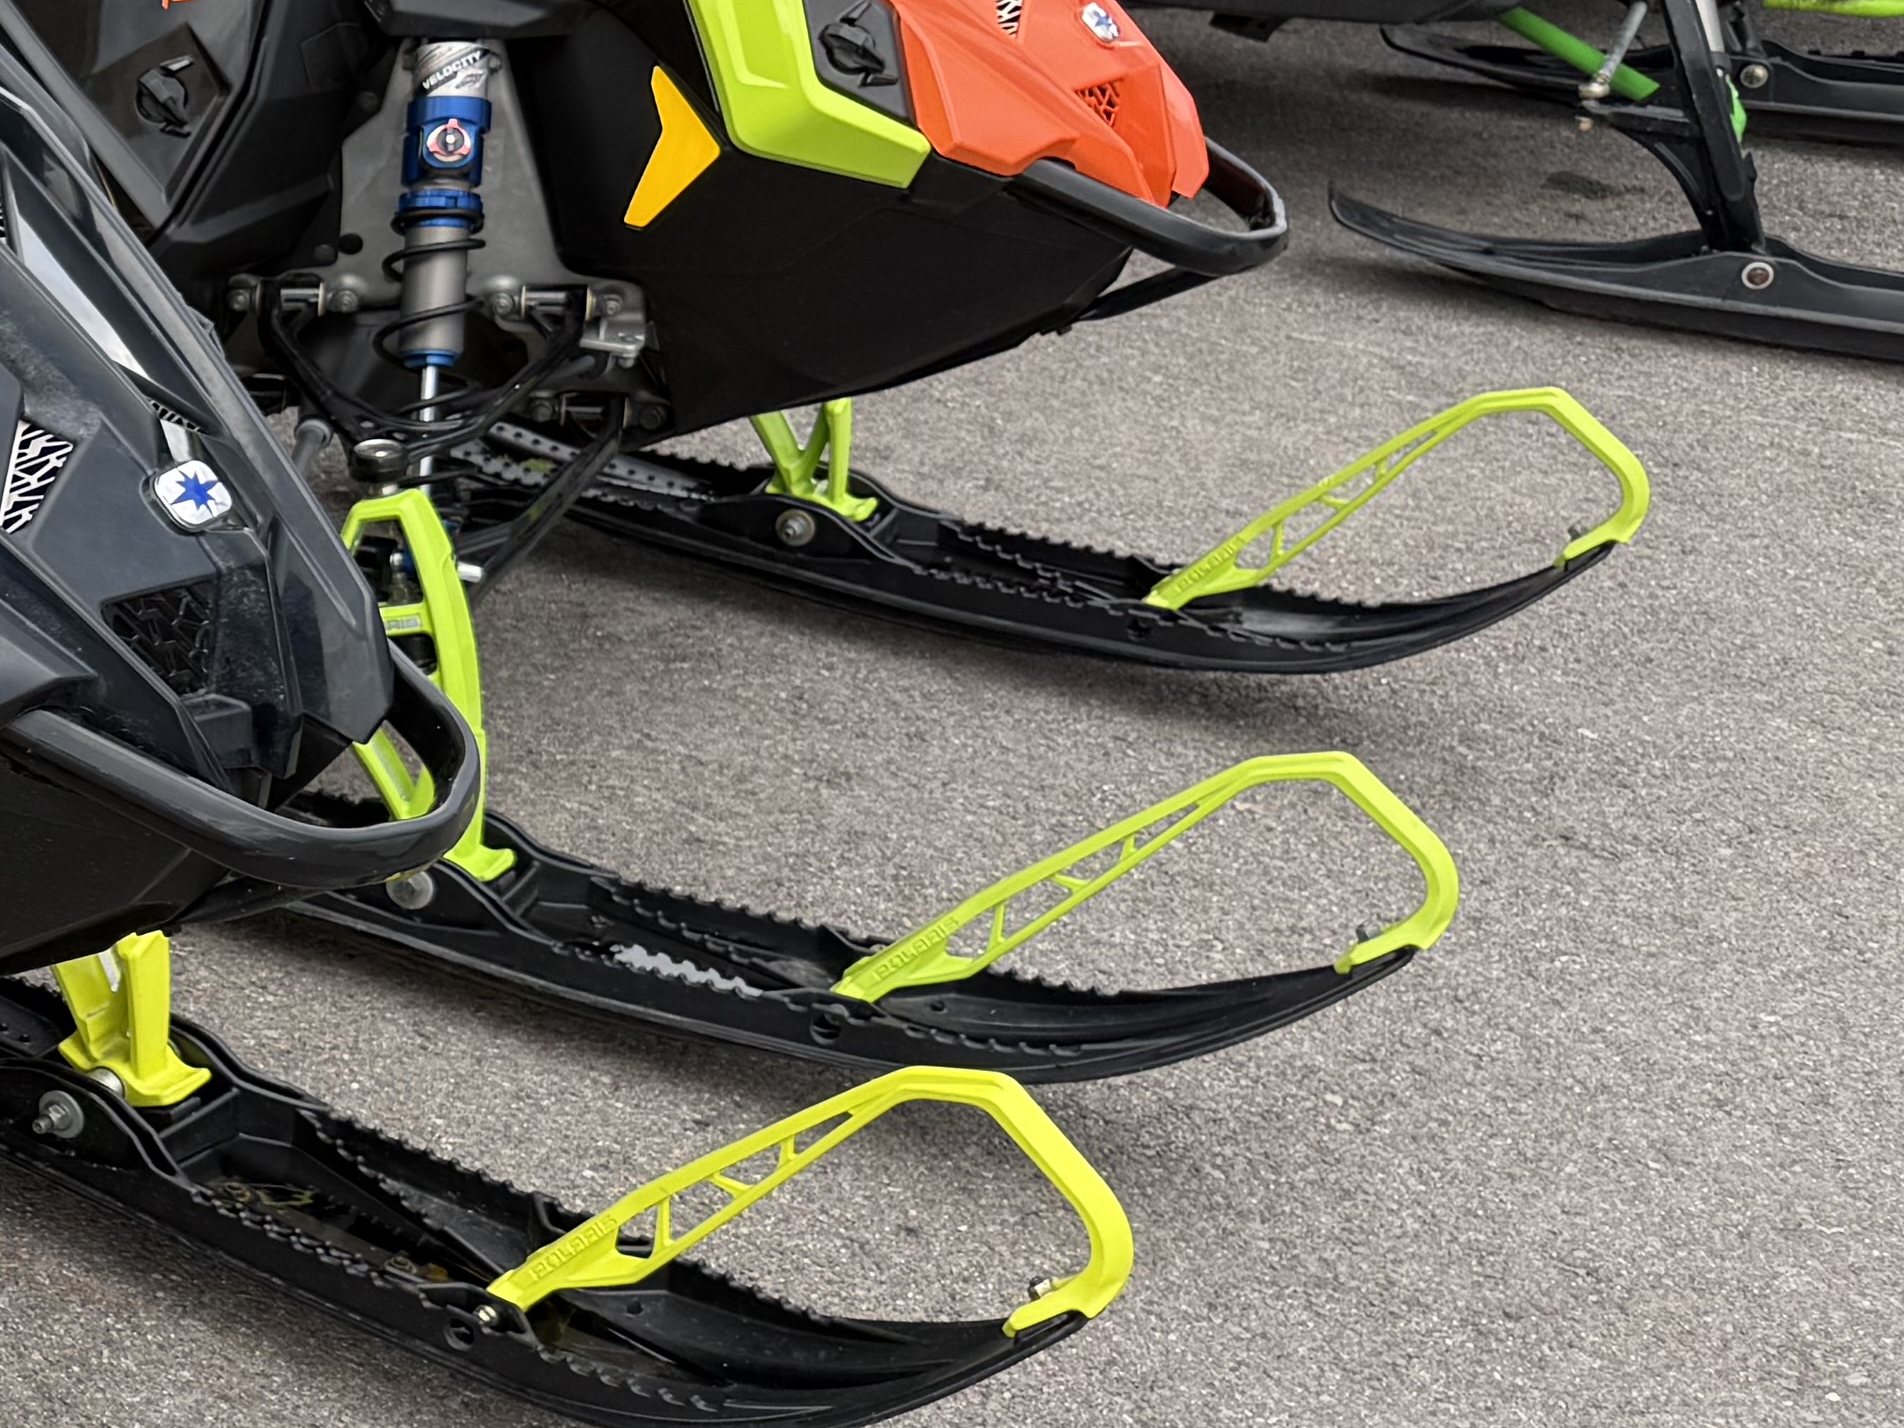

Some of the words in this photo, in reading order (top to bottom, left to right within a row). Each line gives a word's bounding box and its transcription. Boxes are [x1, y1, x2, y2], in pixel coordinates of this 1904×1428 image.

[422, 50, 482, 90] VELOCITY
[875, 916, 959, 981] POLARIS
[532, 1213, 619, 1281] POLARIS
